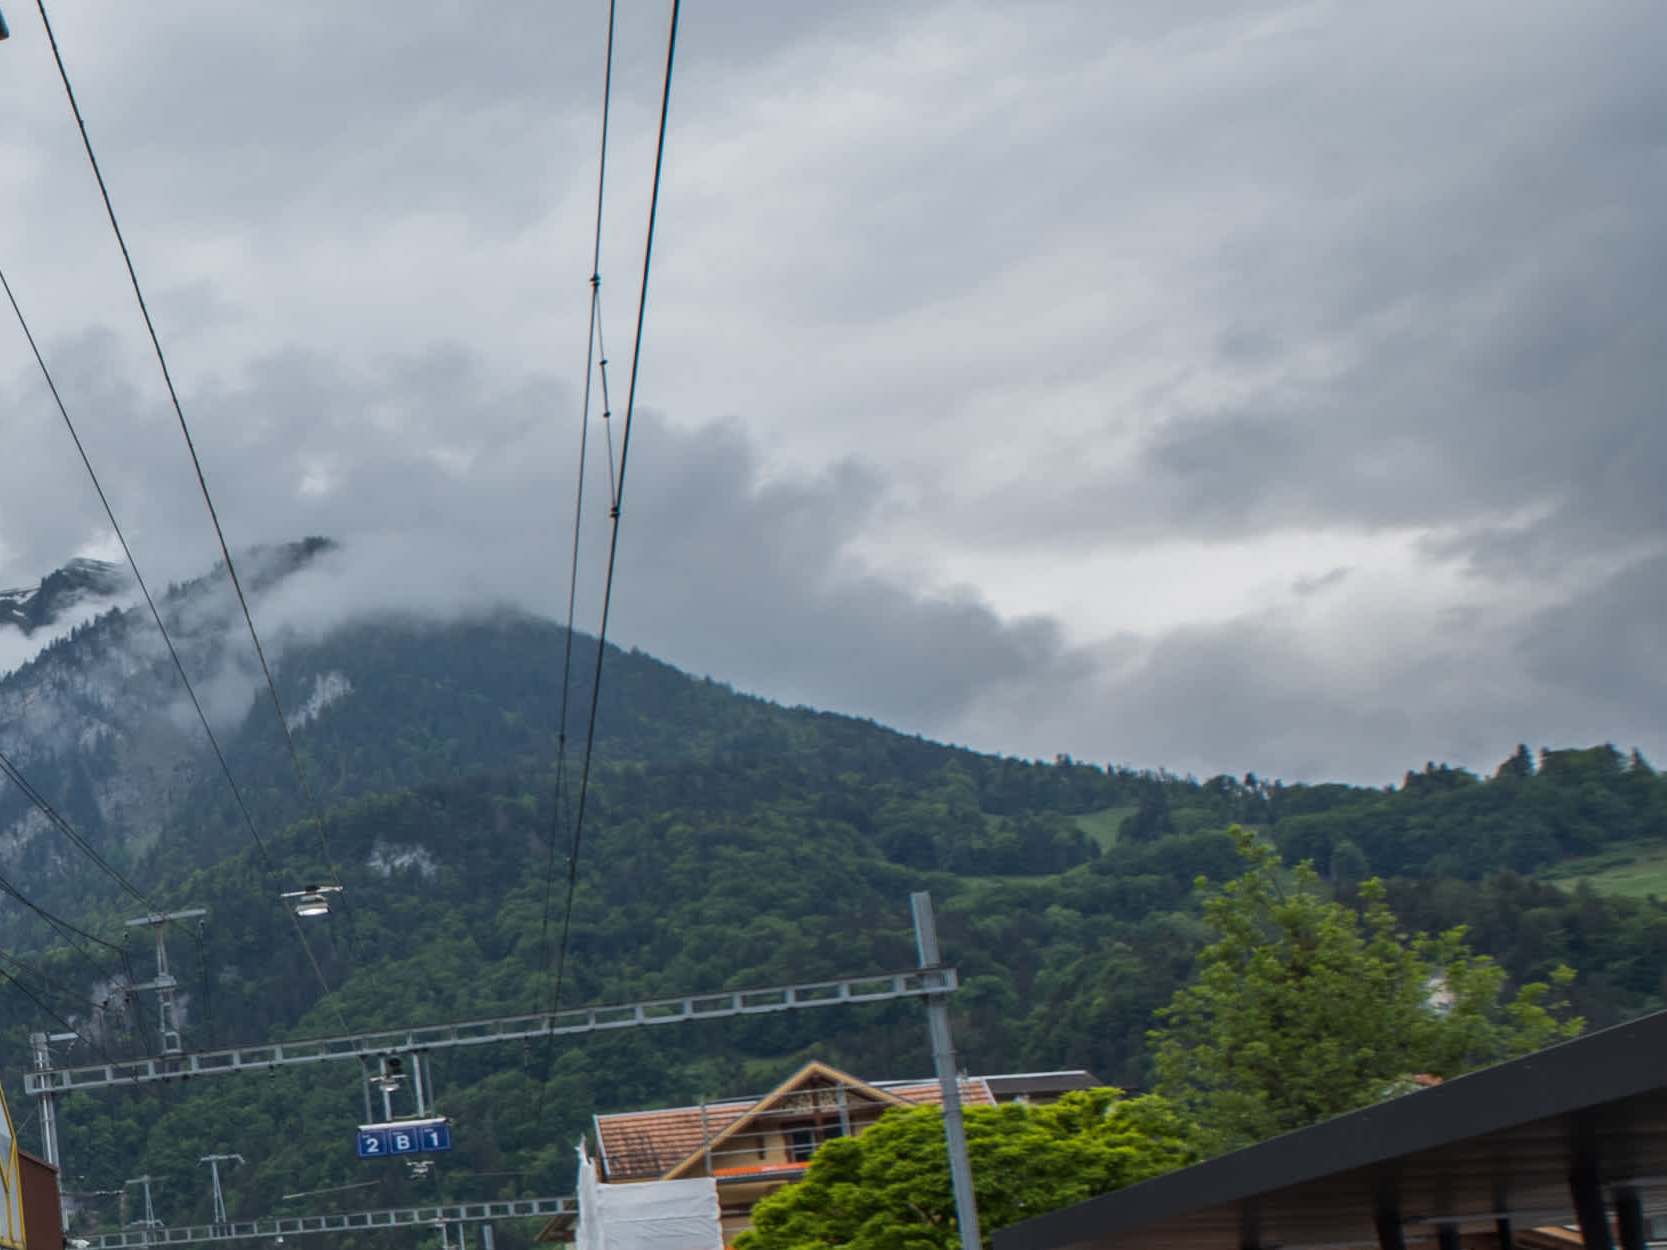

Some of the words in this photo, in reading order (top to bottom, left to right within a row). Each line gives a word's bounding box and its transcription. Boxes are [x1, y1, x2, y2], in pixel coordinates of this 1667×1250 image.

[366, 1138, 379, 1153] 2
[396, 1135, 411, 1150] B
[429, 1132, 439, 1147] 1
